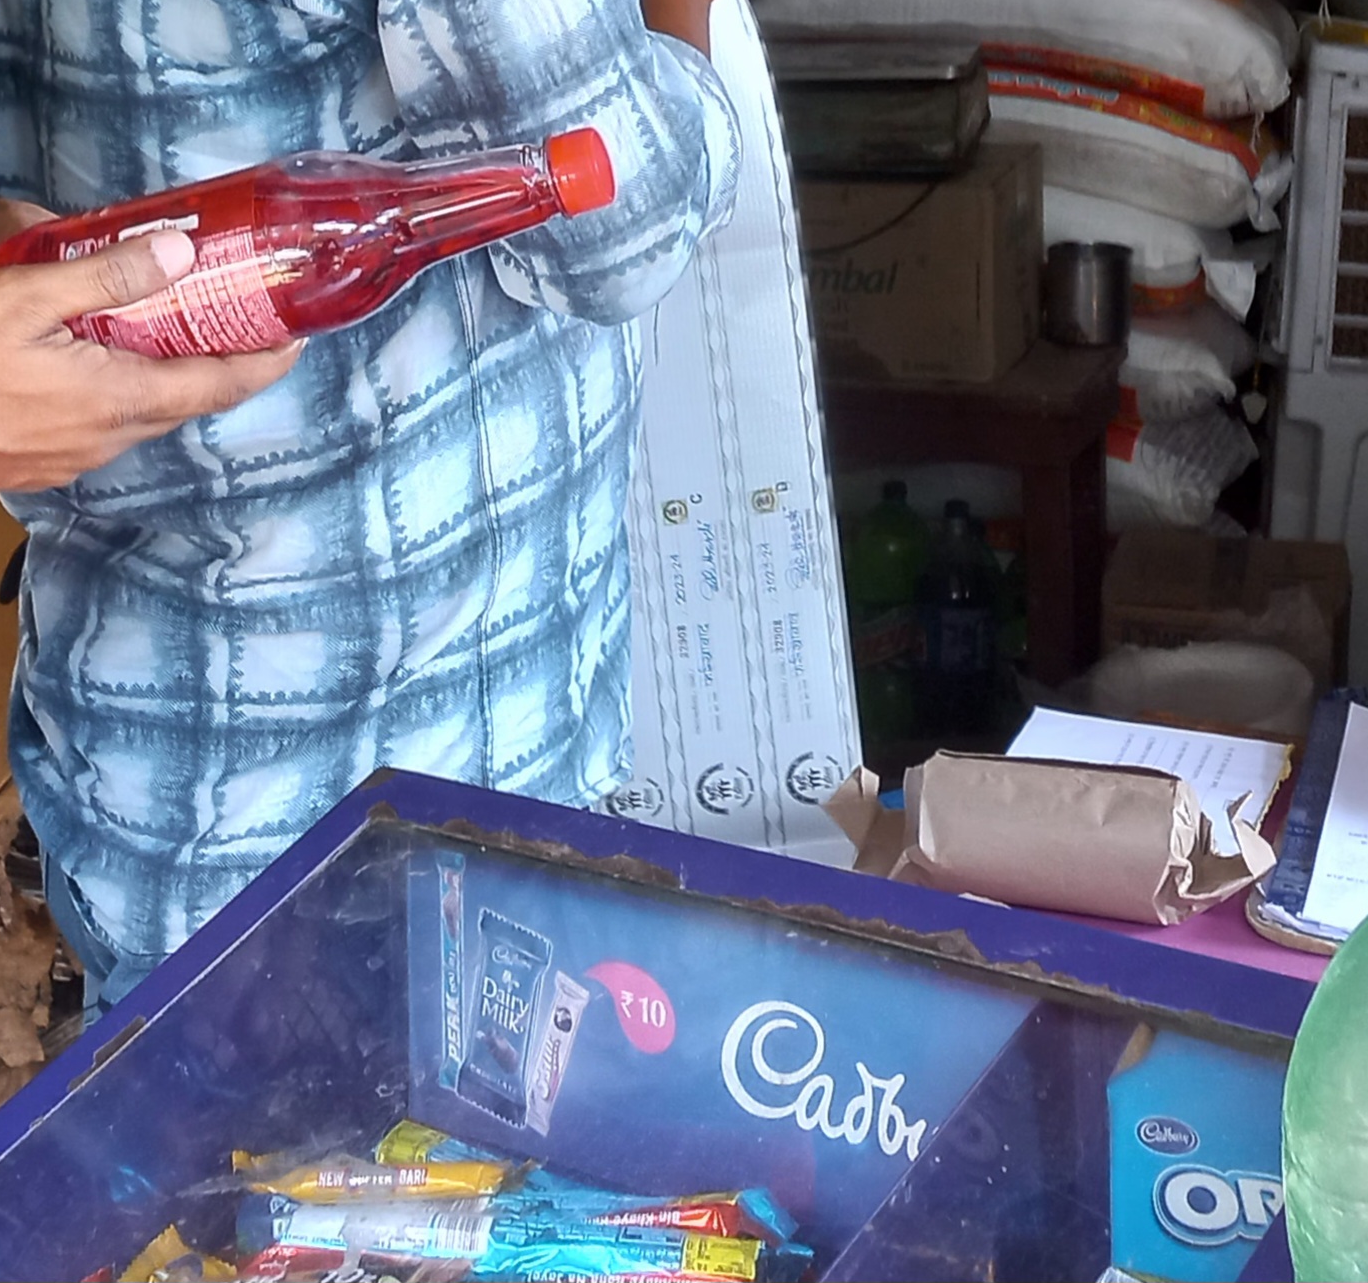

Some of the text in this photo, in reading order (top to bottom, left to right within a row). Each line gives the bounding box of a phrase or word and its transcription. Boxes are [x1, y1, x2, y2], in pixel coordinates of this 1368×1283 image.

[690, 493, 702, 504] C
[483, 976, 529, 1014] Dairy
[482, 998, 524, 1034] Milk
[1140, 1120, 1195, 1150] Cadbury
[319, 1171, 344, 1187] NEW
